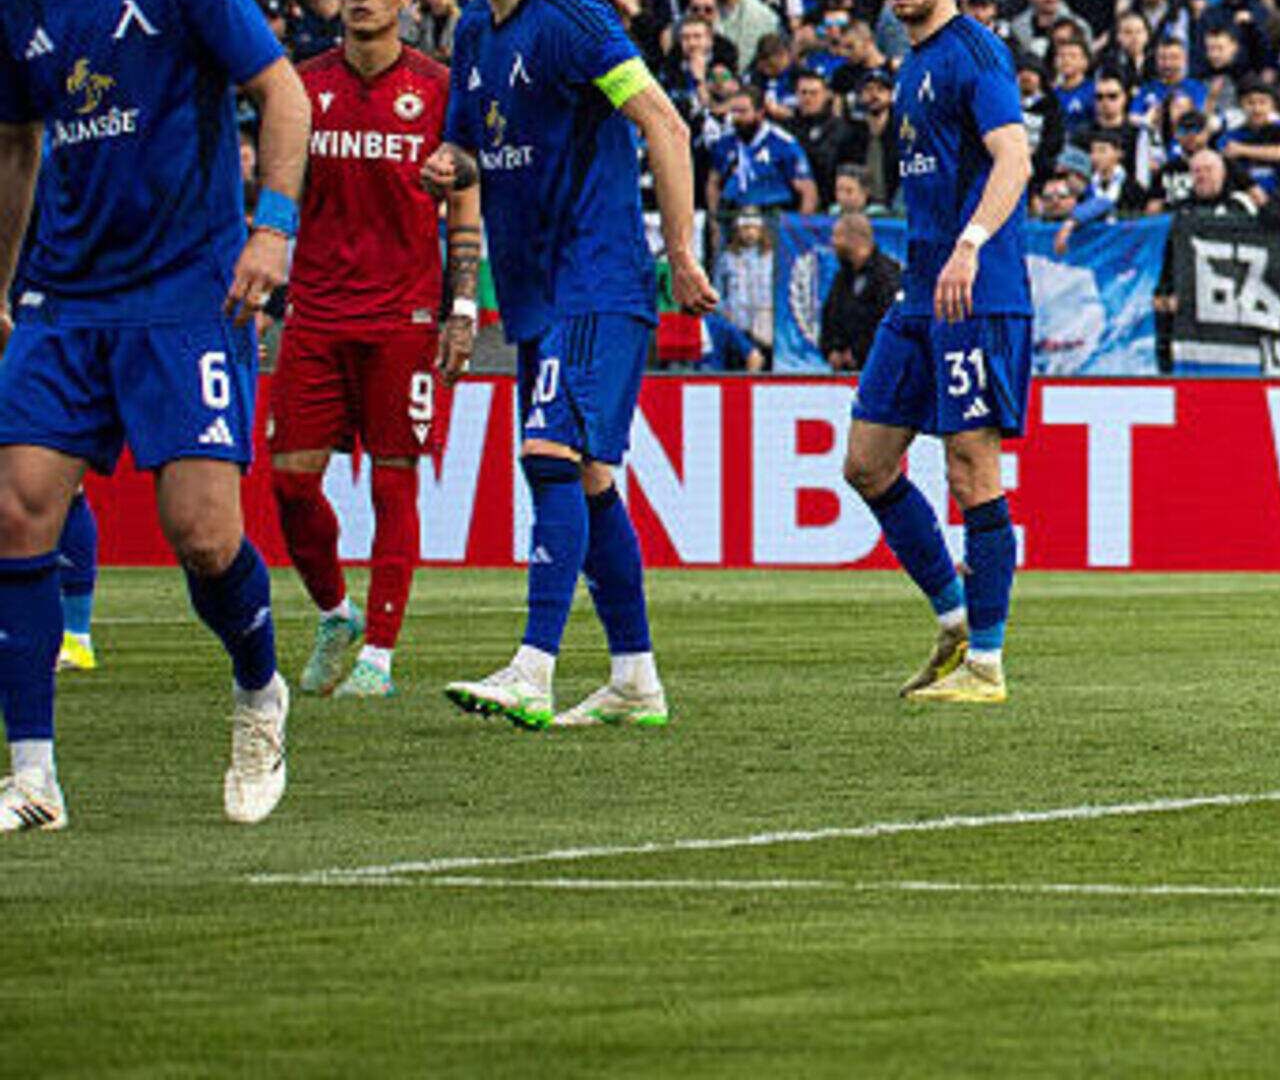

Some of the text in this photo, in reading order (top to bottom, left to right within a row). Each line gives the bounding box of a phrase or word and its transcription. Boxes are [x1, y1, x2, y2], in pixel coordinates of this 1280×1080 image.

[310, 129, 424, 163] WINBET
[199, 351, 231, 410] 6
[408, 372, 434, 421] 9
[531, 358, 559, 406] 0
[944, 348, 987, 397] 31
